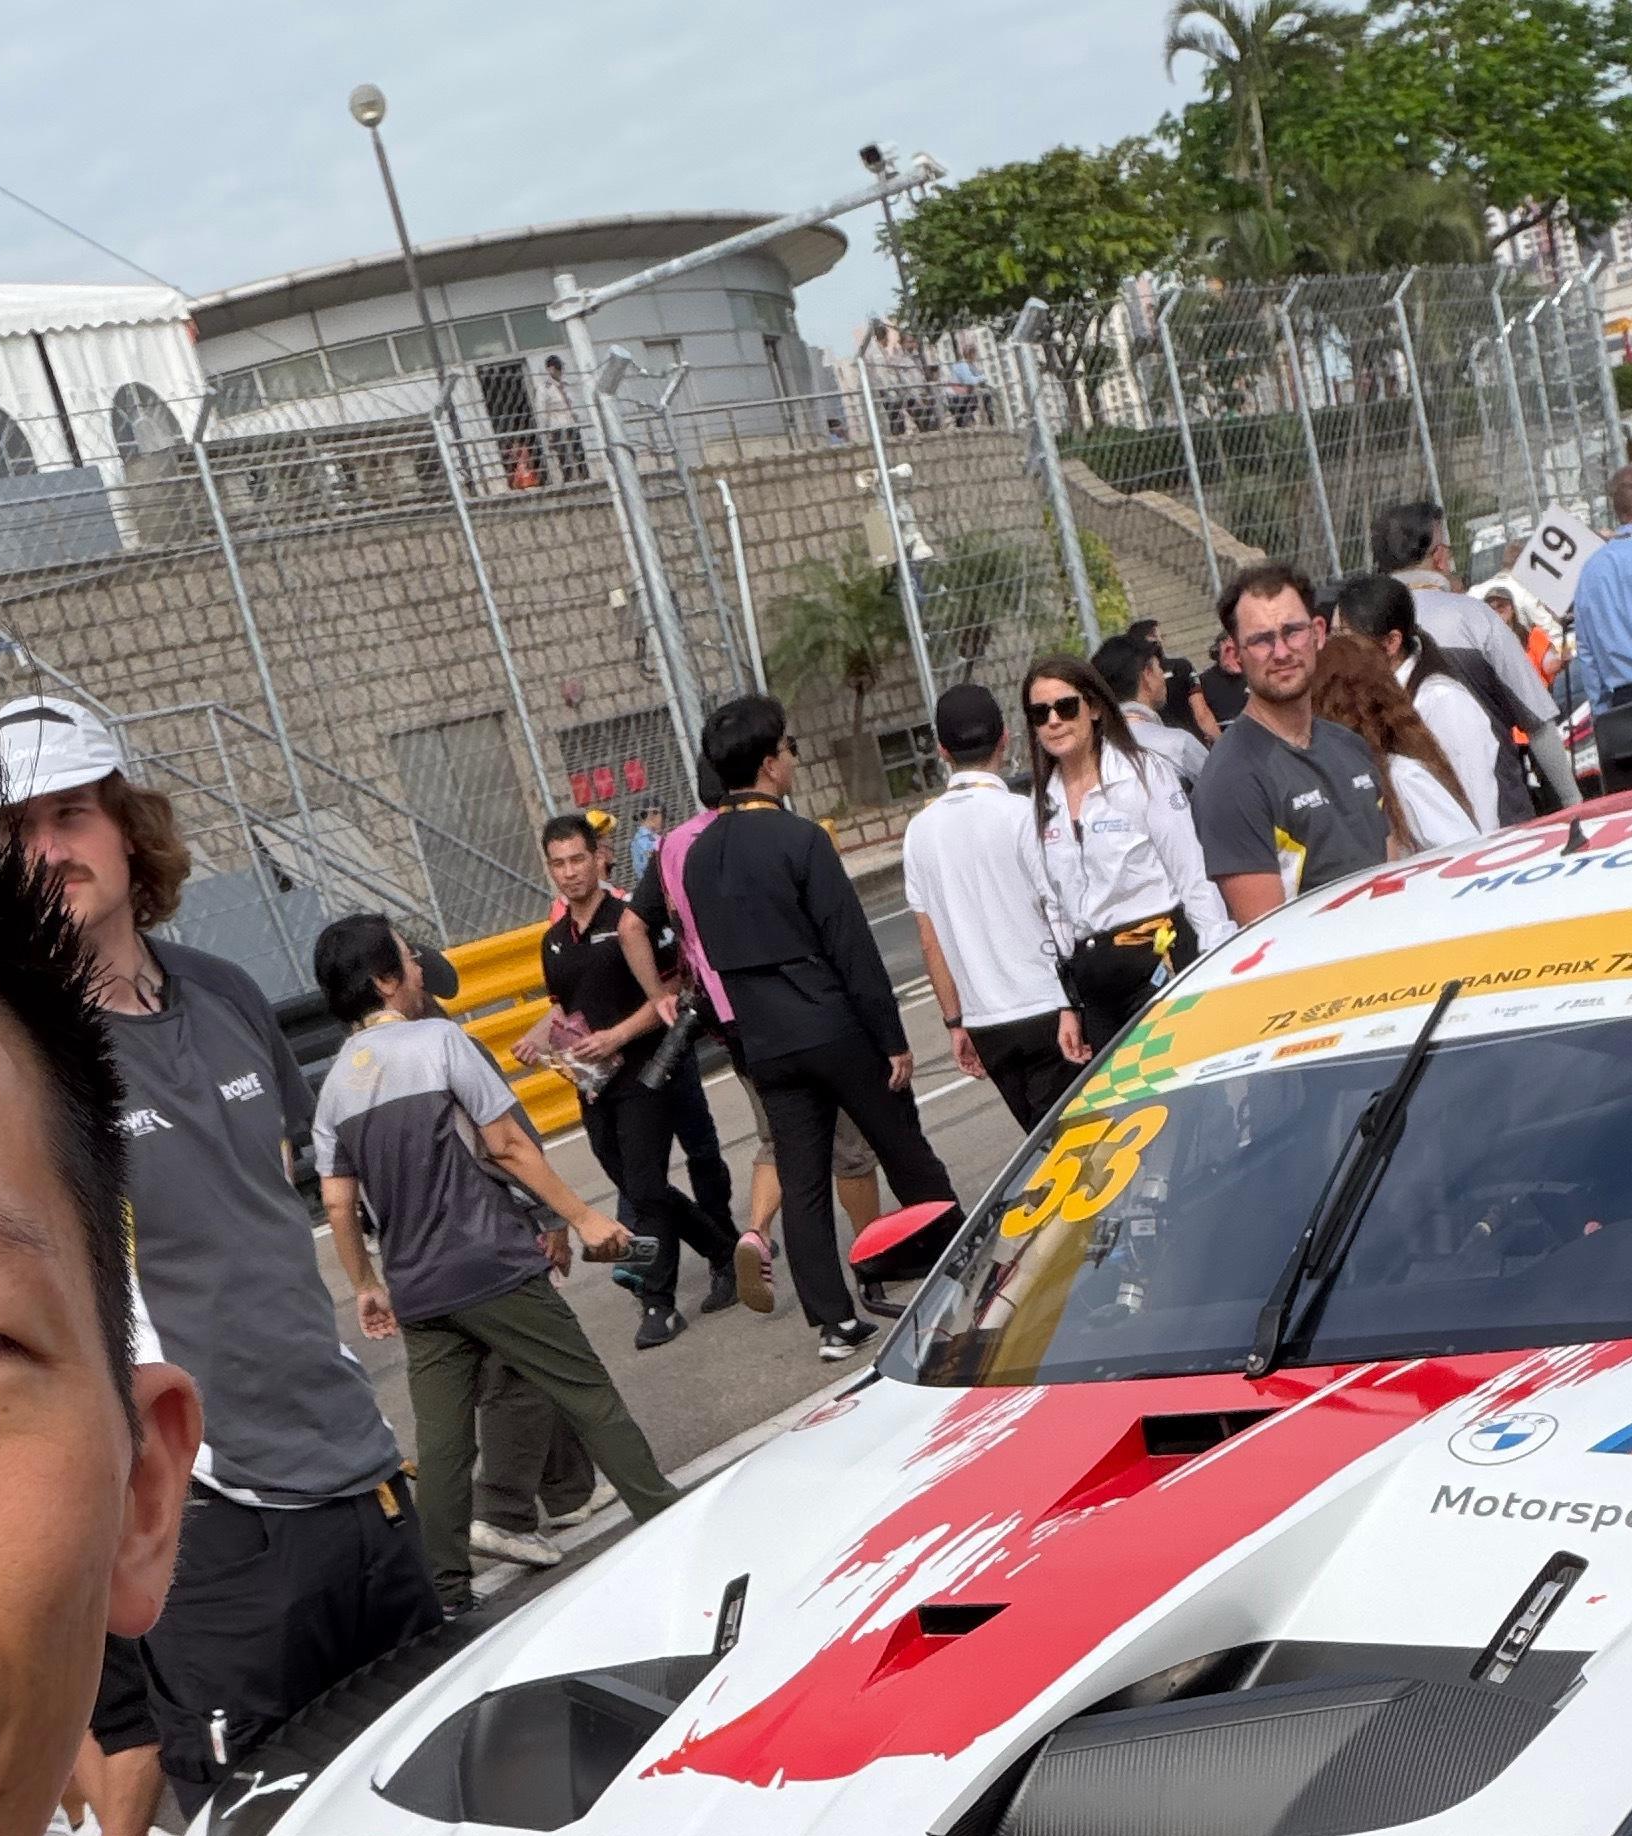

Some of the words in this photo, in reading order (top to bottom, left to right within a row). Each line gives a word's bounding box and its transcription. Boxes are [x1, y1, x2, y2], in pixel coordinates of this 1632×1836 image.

[1531, 526, 1577, 581] 19
[1259, 1010, 1296, 1034] 72
[1351, 982, 1437, 1009] MACAU
[1536, 957, 1600, 979] PRIX
[218, 1072, 262, 1101] ROWE
[1000, 1105, 1169, 1239] 53
